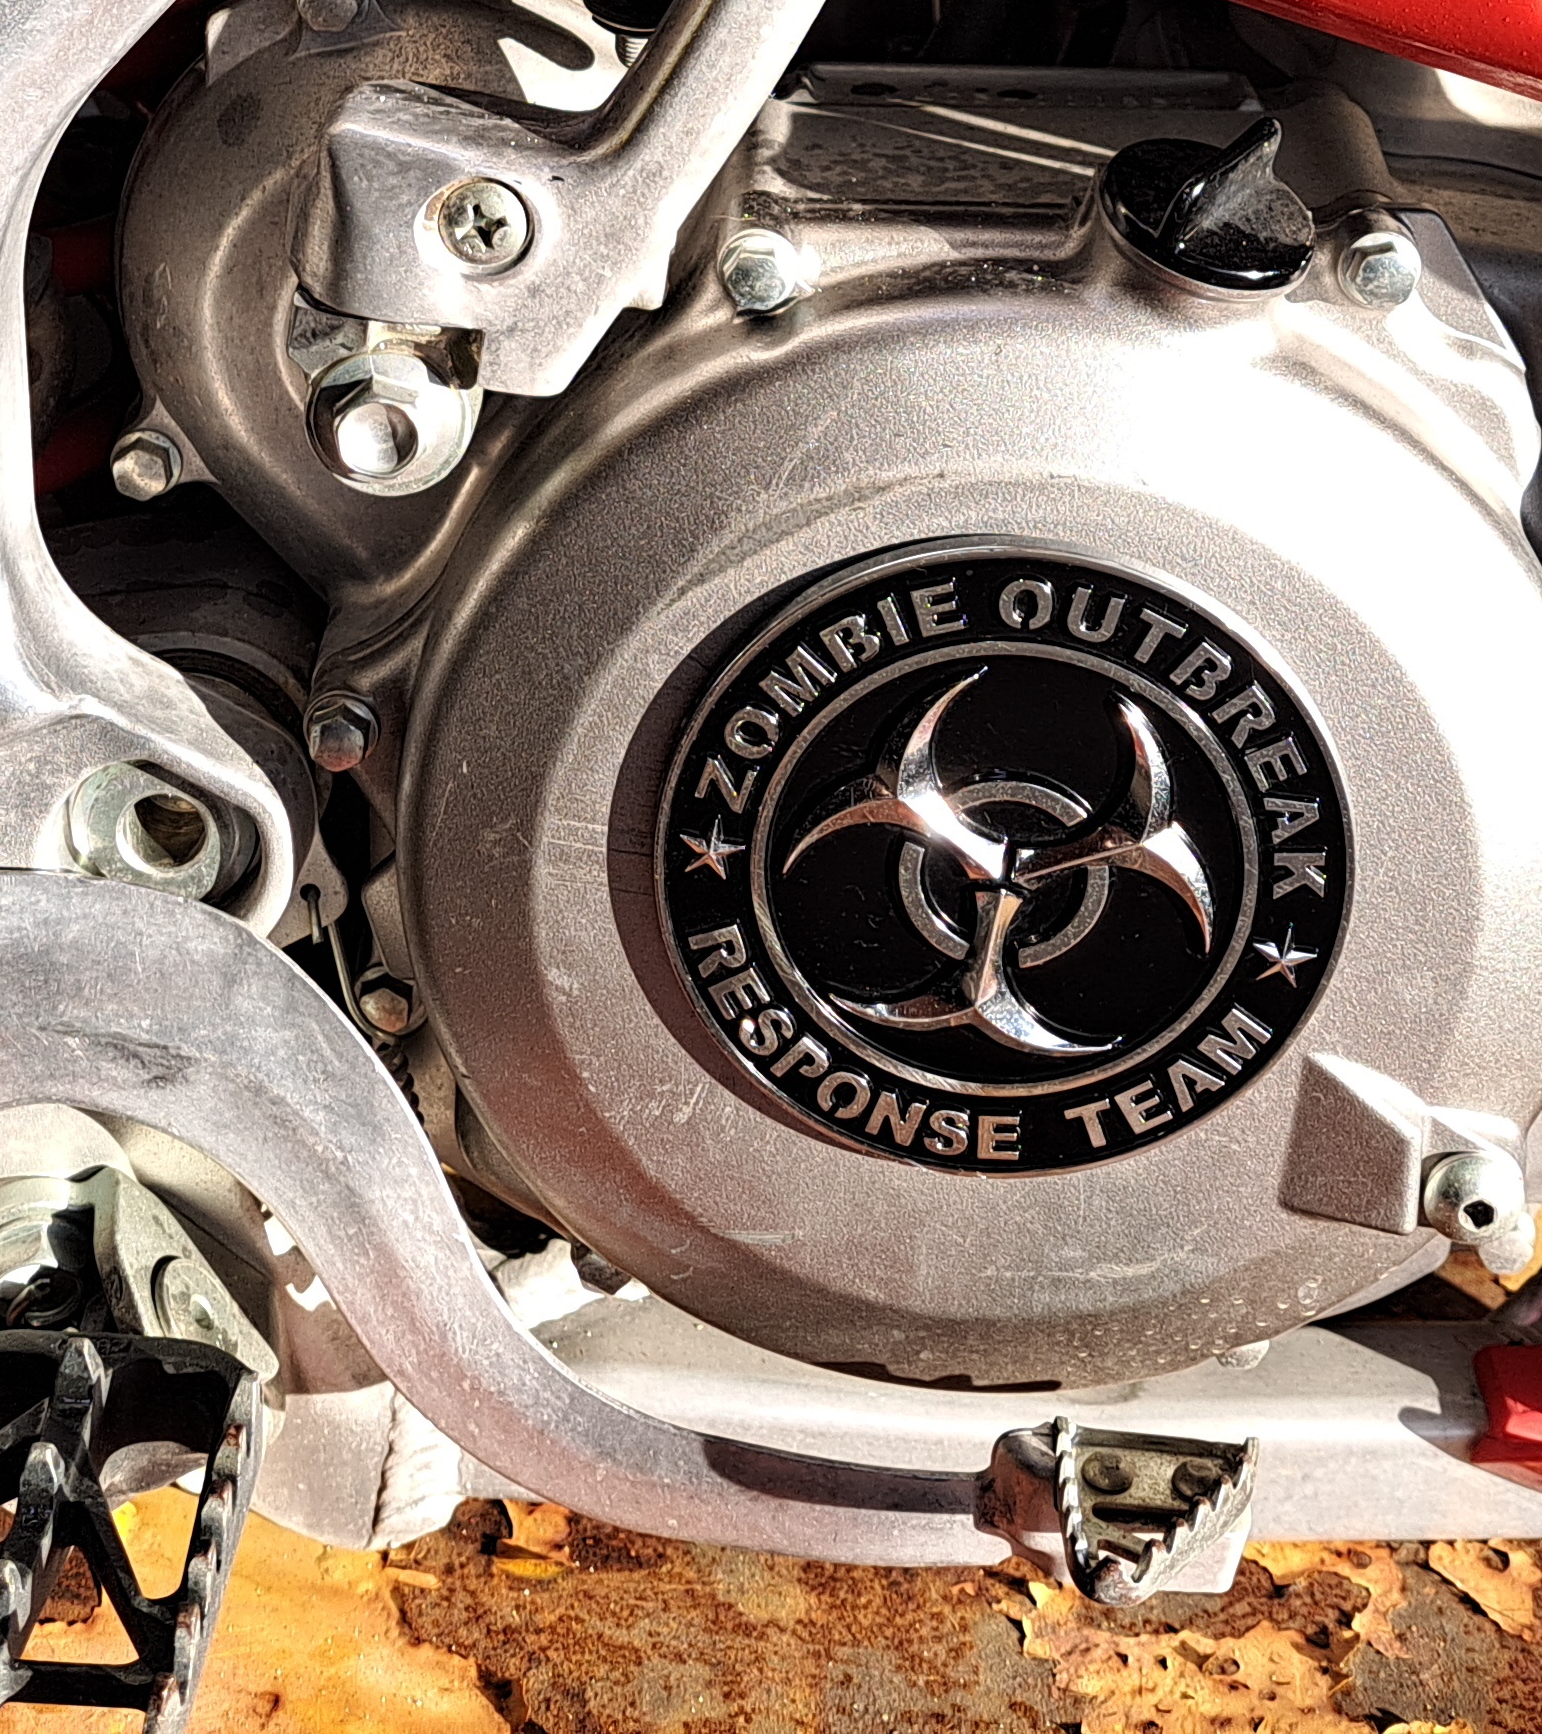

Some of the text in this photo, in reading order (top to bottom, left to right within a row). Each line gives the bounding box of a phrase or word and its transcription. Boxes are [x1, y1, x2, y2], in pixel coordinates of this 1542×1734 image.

[694, 577, 1326, 899] ZOMBIE OUTBREAK
[689, 923, 1272, 1161] RESPONSE TEAM
